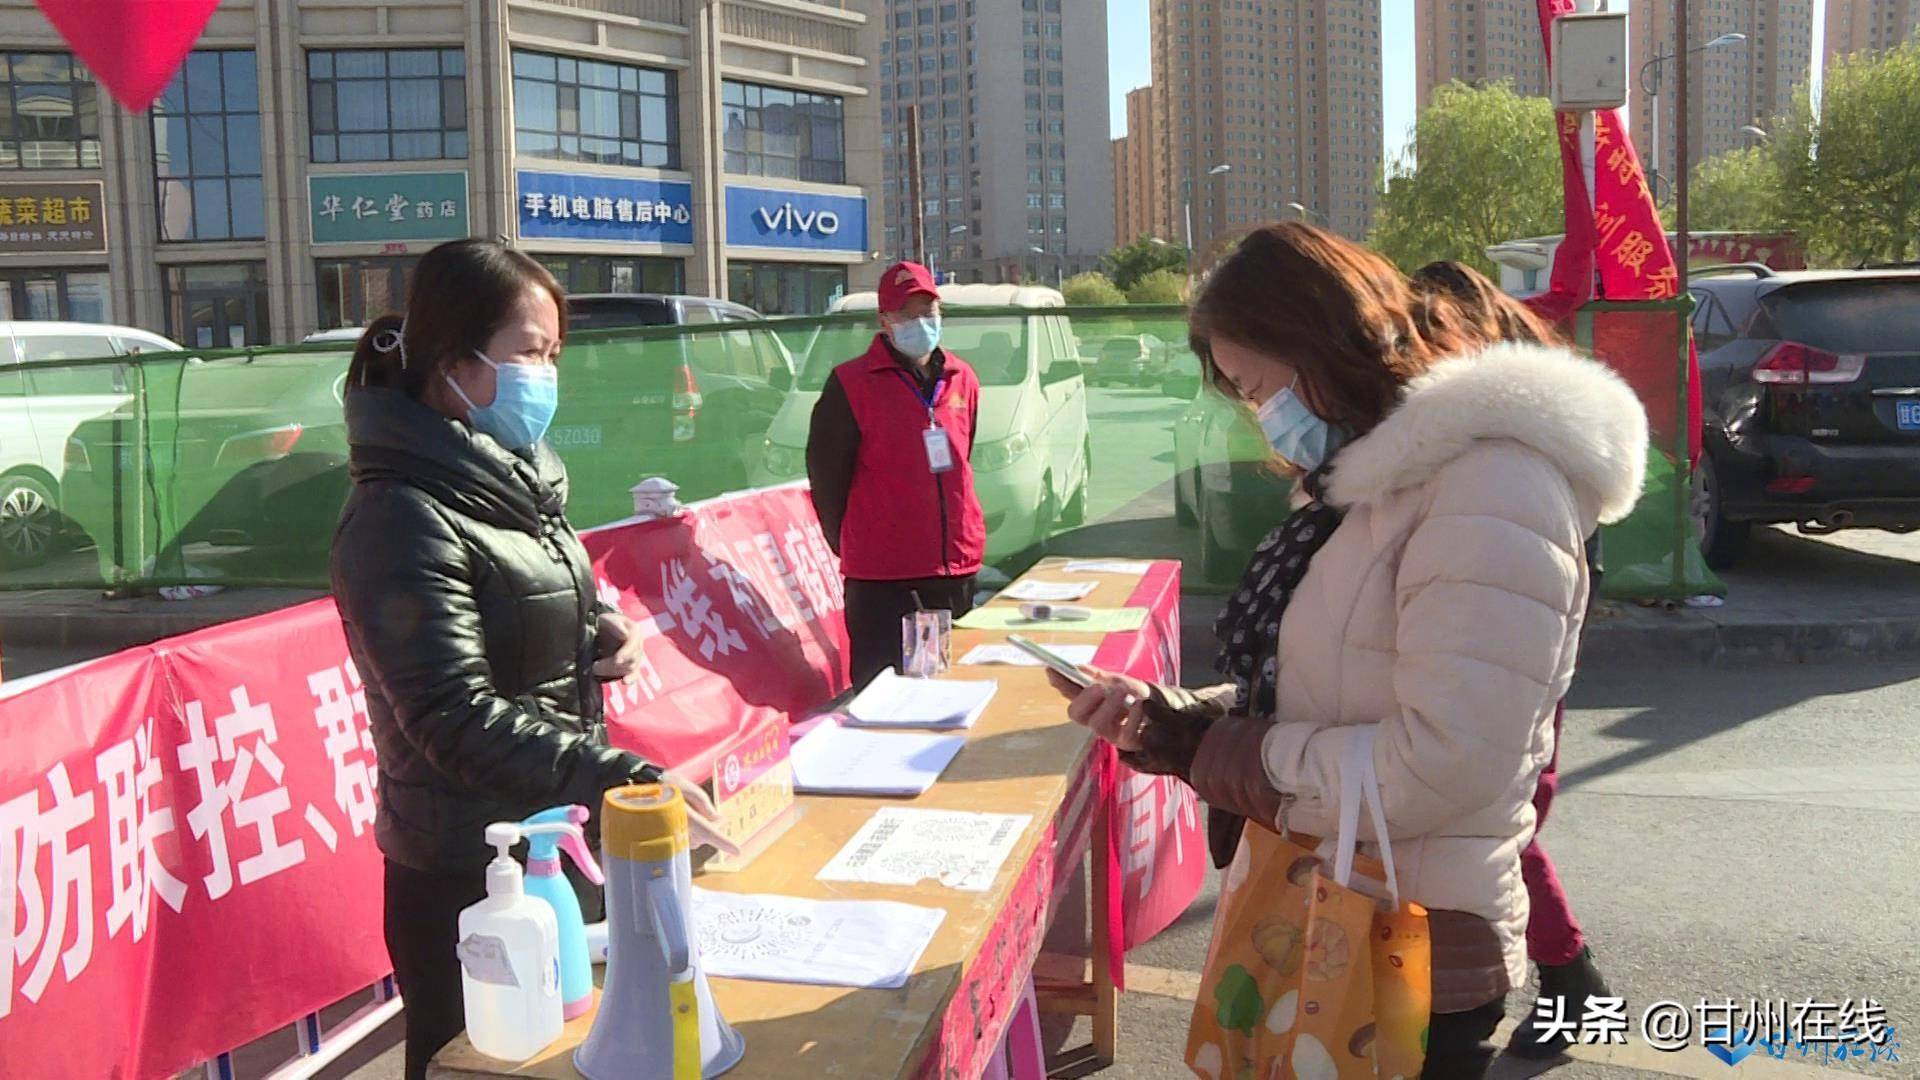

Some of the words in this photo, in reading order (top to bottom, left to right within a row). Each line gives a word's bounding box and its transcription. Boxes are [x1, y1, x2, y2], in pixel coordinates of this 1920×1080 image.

[319, 193, 457, 222] 华仁堂药店
[524, 192, 690, 224] 手机电脑售后中心
[759, 202, 840, 235] vivo
